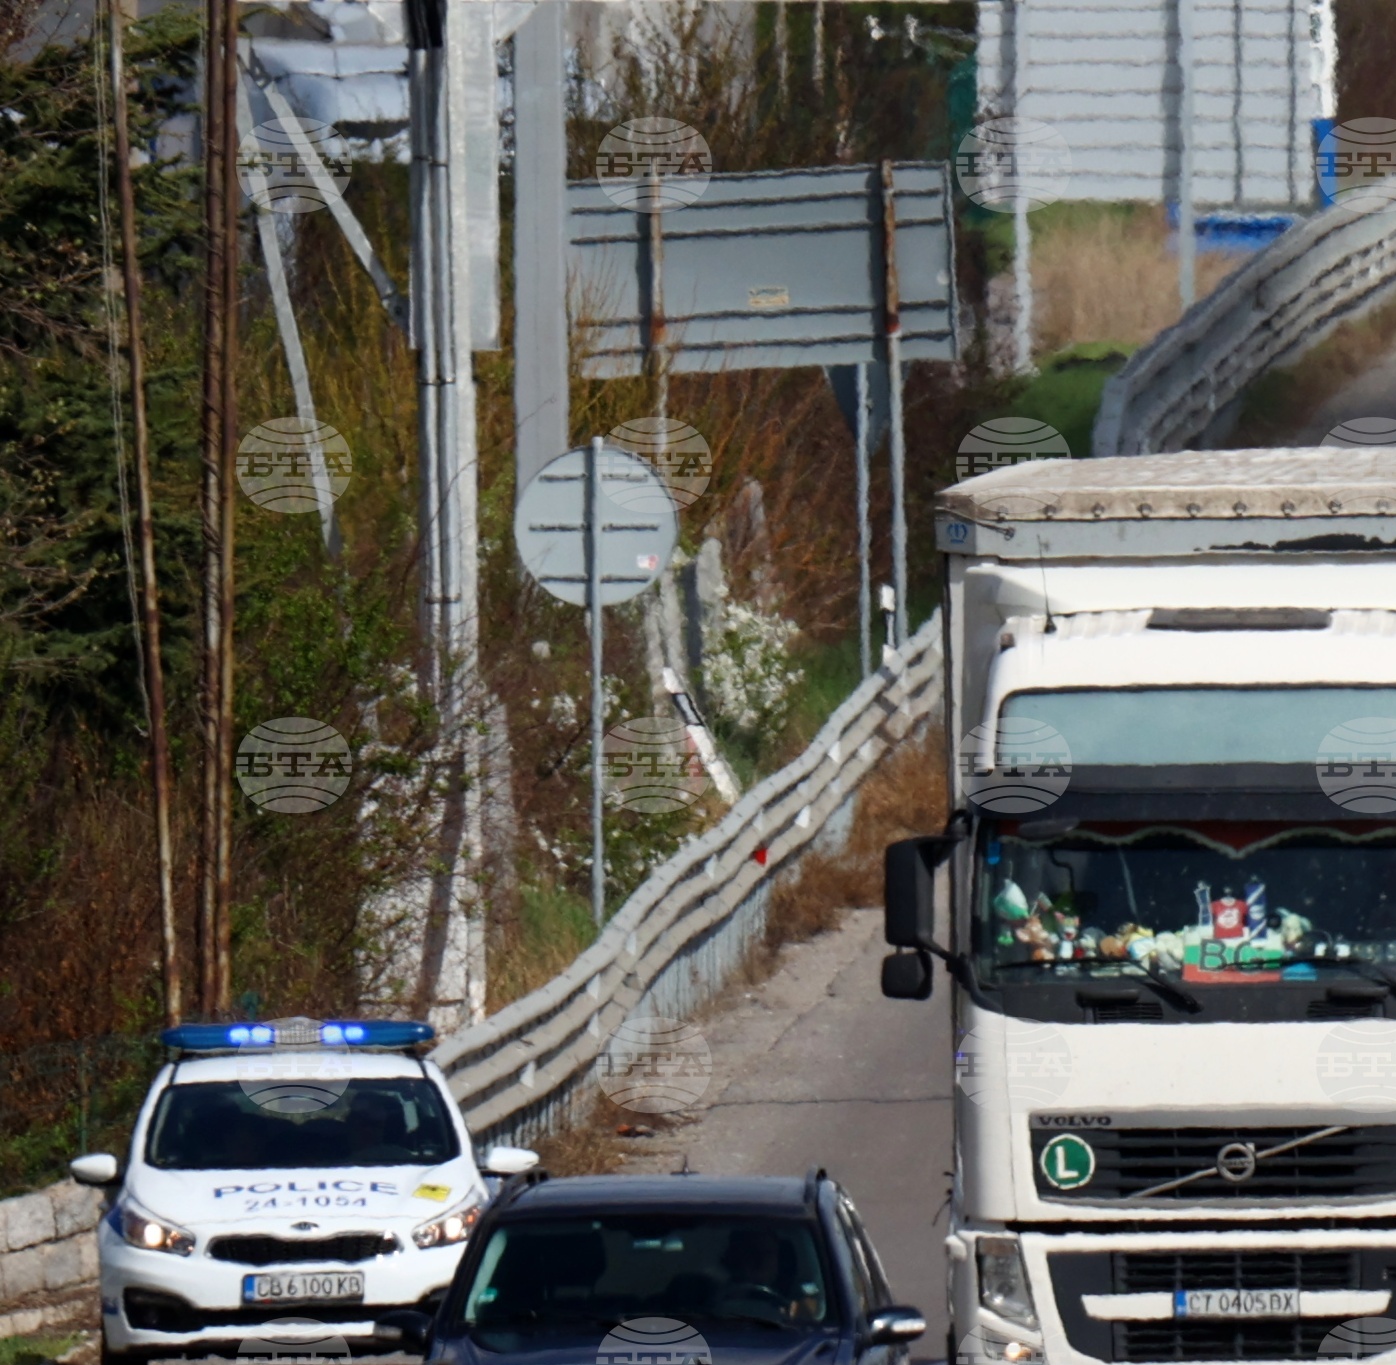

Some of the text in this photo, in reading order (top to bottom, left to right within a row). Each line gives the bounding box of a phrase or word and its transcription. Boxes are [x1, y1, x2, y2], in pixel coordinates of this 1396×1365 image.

[1038, 1113, 1112, 1127] VOLVO
[1055, 1146, 1079, 1179] L
[214, 1179, 400, 1199] POLICE
[287, 1277, 333, 1296] 6100
